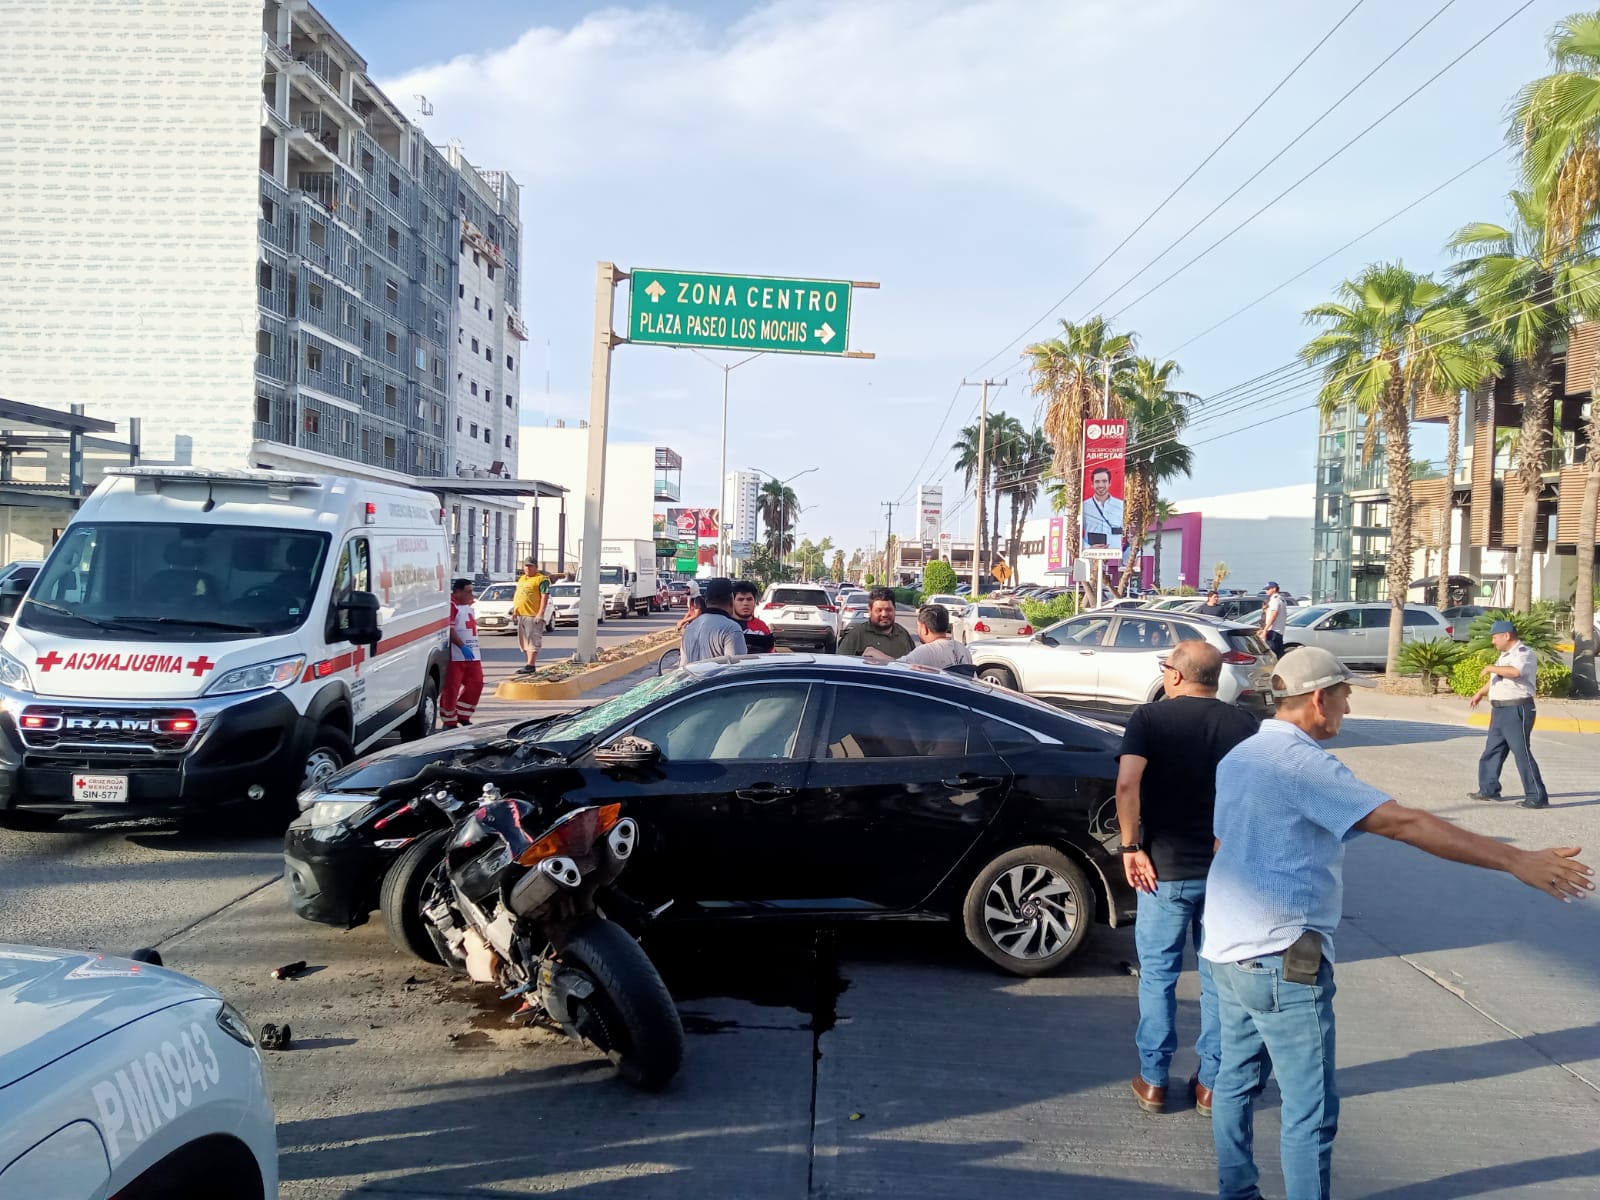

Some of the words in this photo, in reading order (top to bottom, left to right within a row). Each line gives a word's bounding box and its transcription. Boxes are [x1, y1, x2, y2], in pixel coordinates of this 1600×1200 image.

[677, 282, 737, 306] ZONA
[747, 286, 837, 313] CENTRO
[640, 312, 682, 335] PLAZA
[686, 315, 727, 338] PASEO
[731, 317, 756, 339] LOS
[760, 319, 807, 343] MOCHIS
[1101, 424, 1125, 435] UAD
[1086, 452, 1124, 460] ABIERTAS
[66, 717, 151, 731] RAM
[82, 791, 118, 799] SIN-577
[91, 1022, 220, 1160] PM0943
